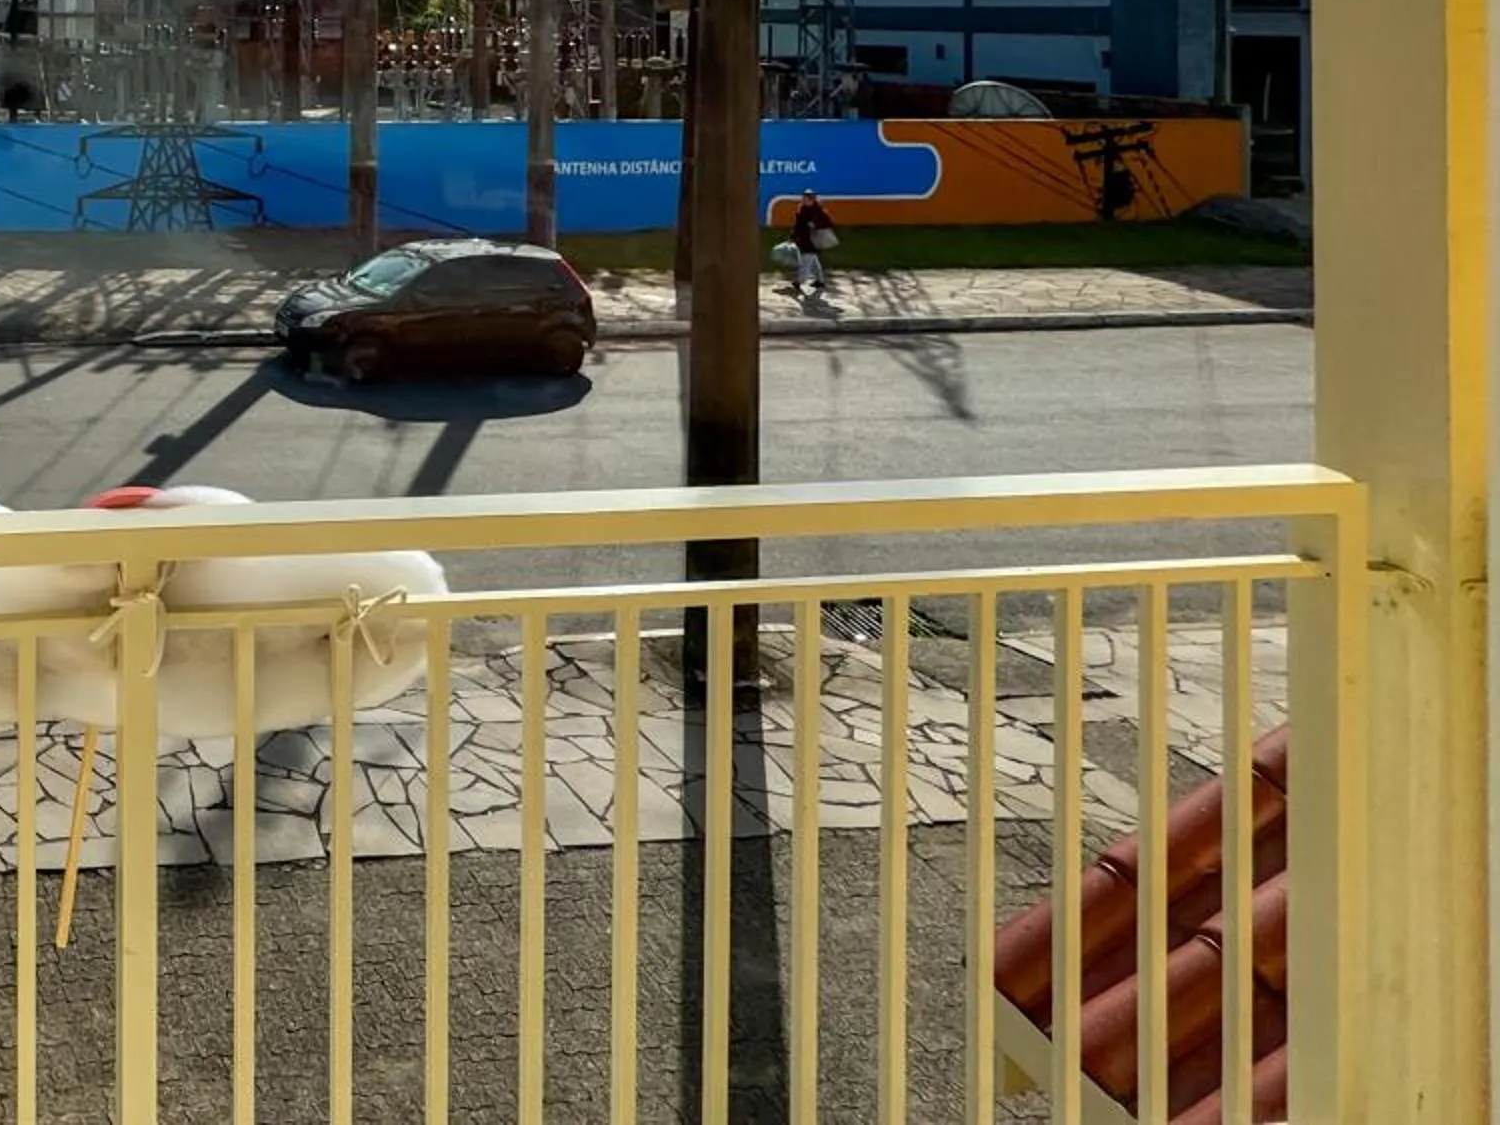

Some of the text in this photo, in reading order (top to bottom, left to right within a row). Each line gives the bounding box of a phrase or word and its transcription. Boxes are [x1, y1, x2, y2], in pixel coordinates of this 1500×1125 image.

[553, 158, 817, 175] ANTENHA DISTÂNCI LÉTRICA
